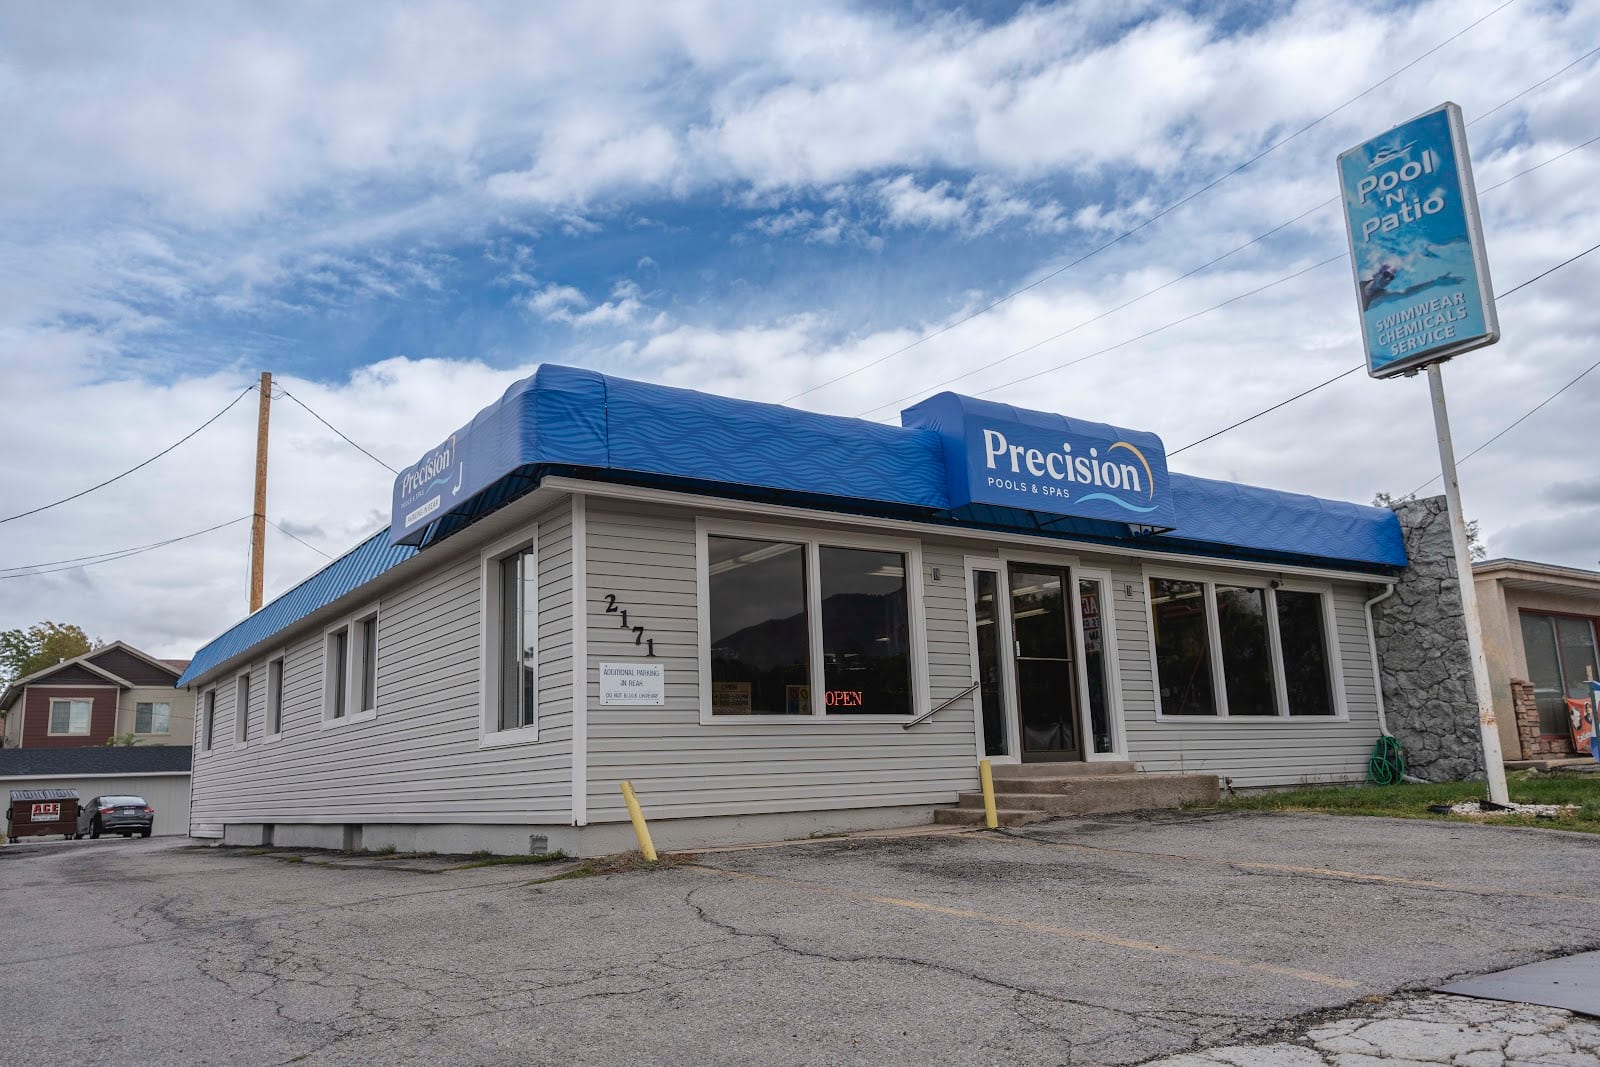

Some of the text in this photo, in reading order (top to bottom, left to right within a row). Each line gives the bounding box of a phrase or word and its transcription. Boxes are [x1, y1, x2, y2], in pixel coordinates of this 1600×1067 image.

[1356, 150, 1434, 204] Pool
[1361, 195, 1445, 242] Patio
[1375, 292, 1466, 332] SWIMWEAR
[1377, 306, 1468, 346] CHEMICALS
[1390, 326, 1456, 357] SERVICE
[401, 449, 450, 498] Precision
[983, 429, 1142, 492] Precision
[987, 477, 1070, 498] POOLS & SPAS
[604, 593, 656, 657] 2171
[603, 669, 634, 677] ADDITIONAL
[825, 691, 863, 706] OPEN
